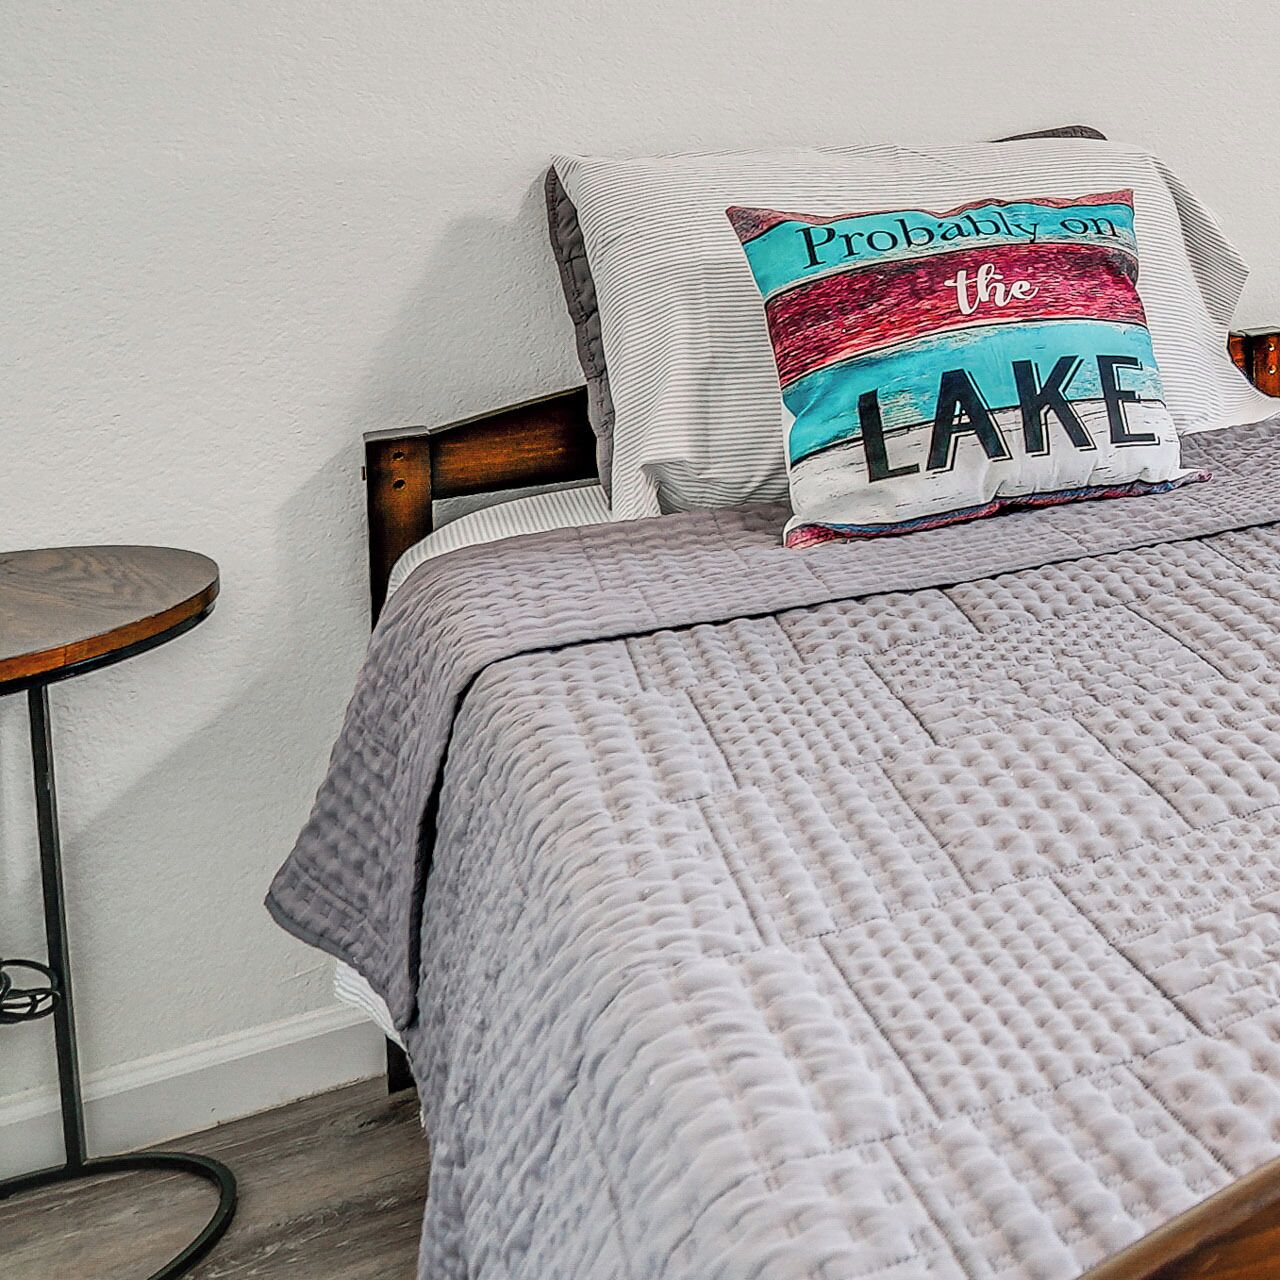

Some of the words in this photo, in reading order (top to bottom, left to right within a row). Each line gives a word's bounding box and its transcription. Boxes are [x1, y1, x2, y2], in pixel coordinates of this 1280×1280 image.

[797, 210, 1040, 271] Probably
[1059, 214, 1121, 238] on
[944, 263, 1041, 316] the
[858, 354, 1161, 483] LAKE
